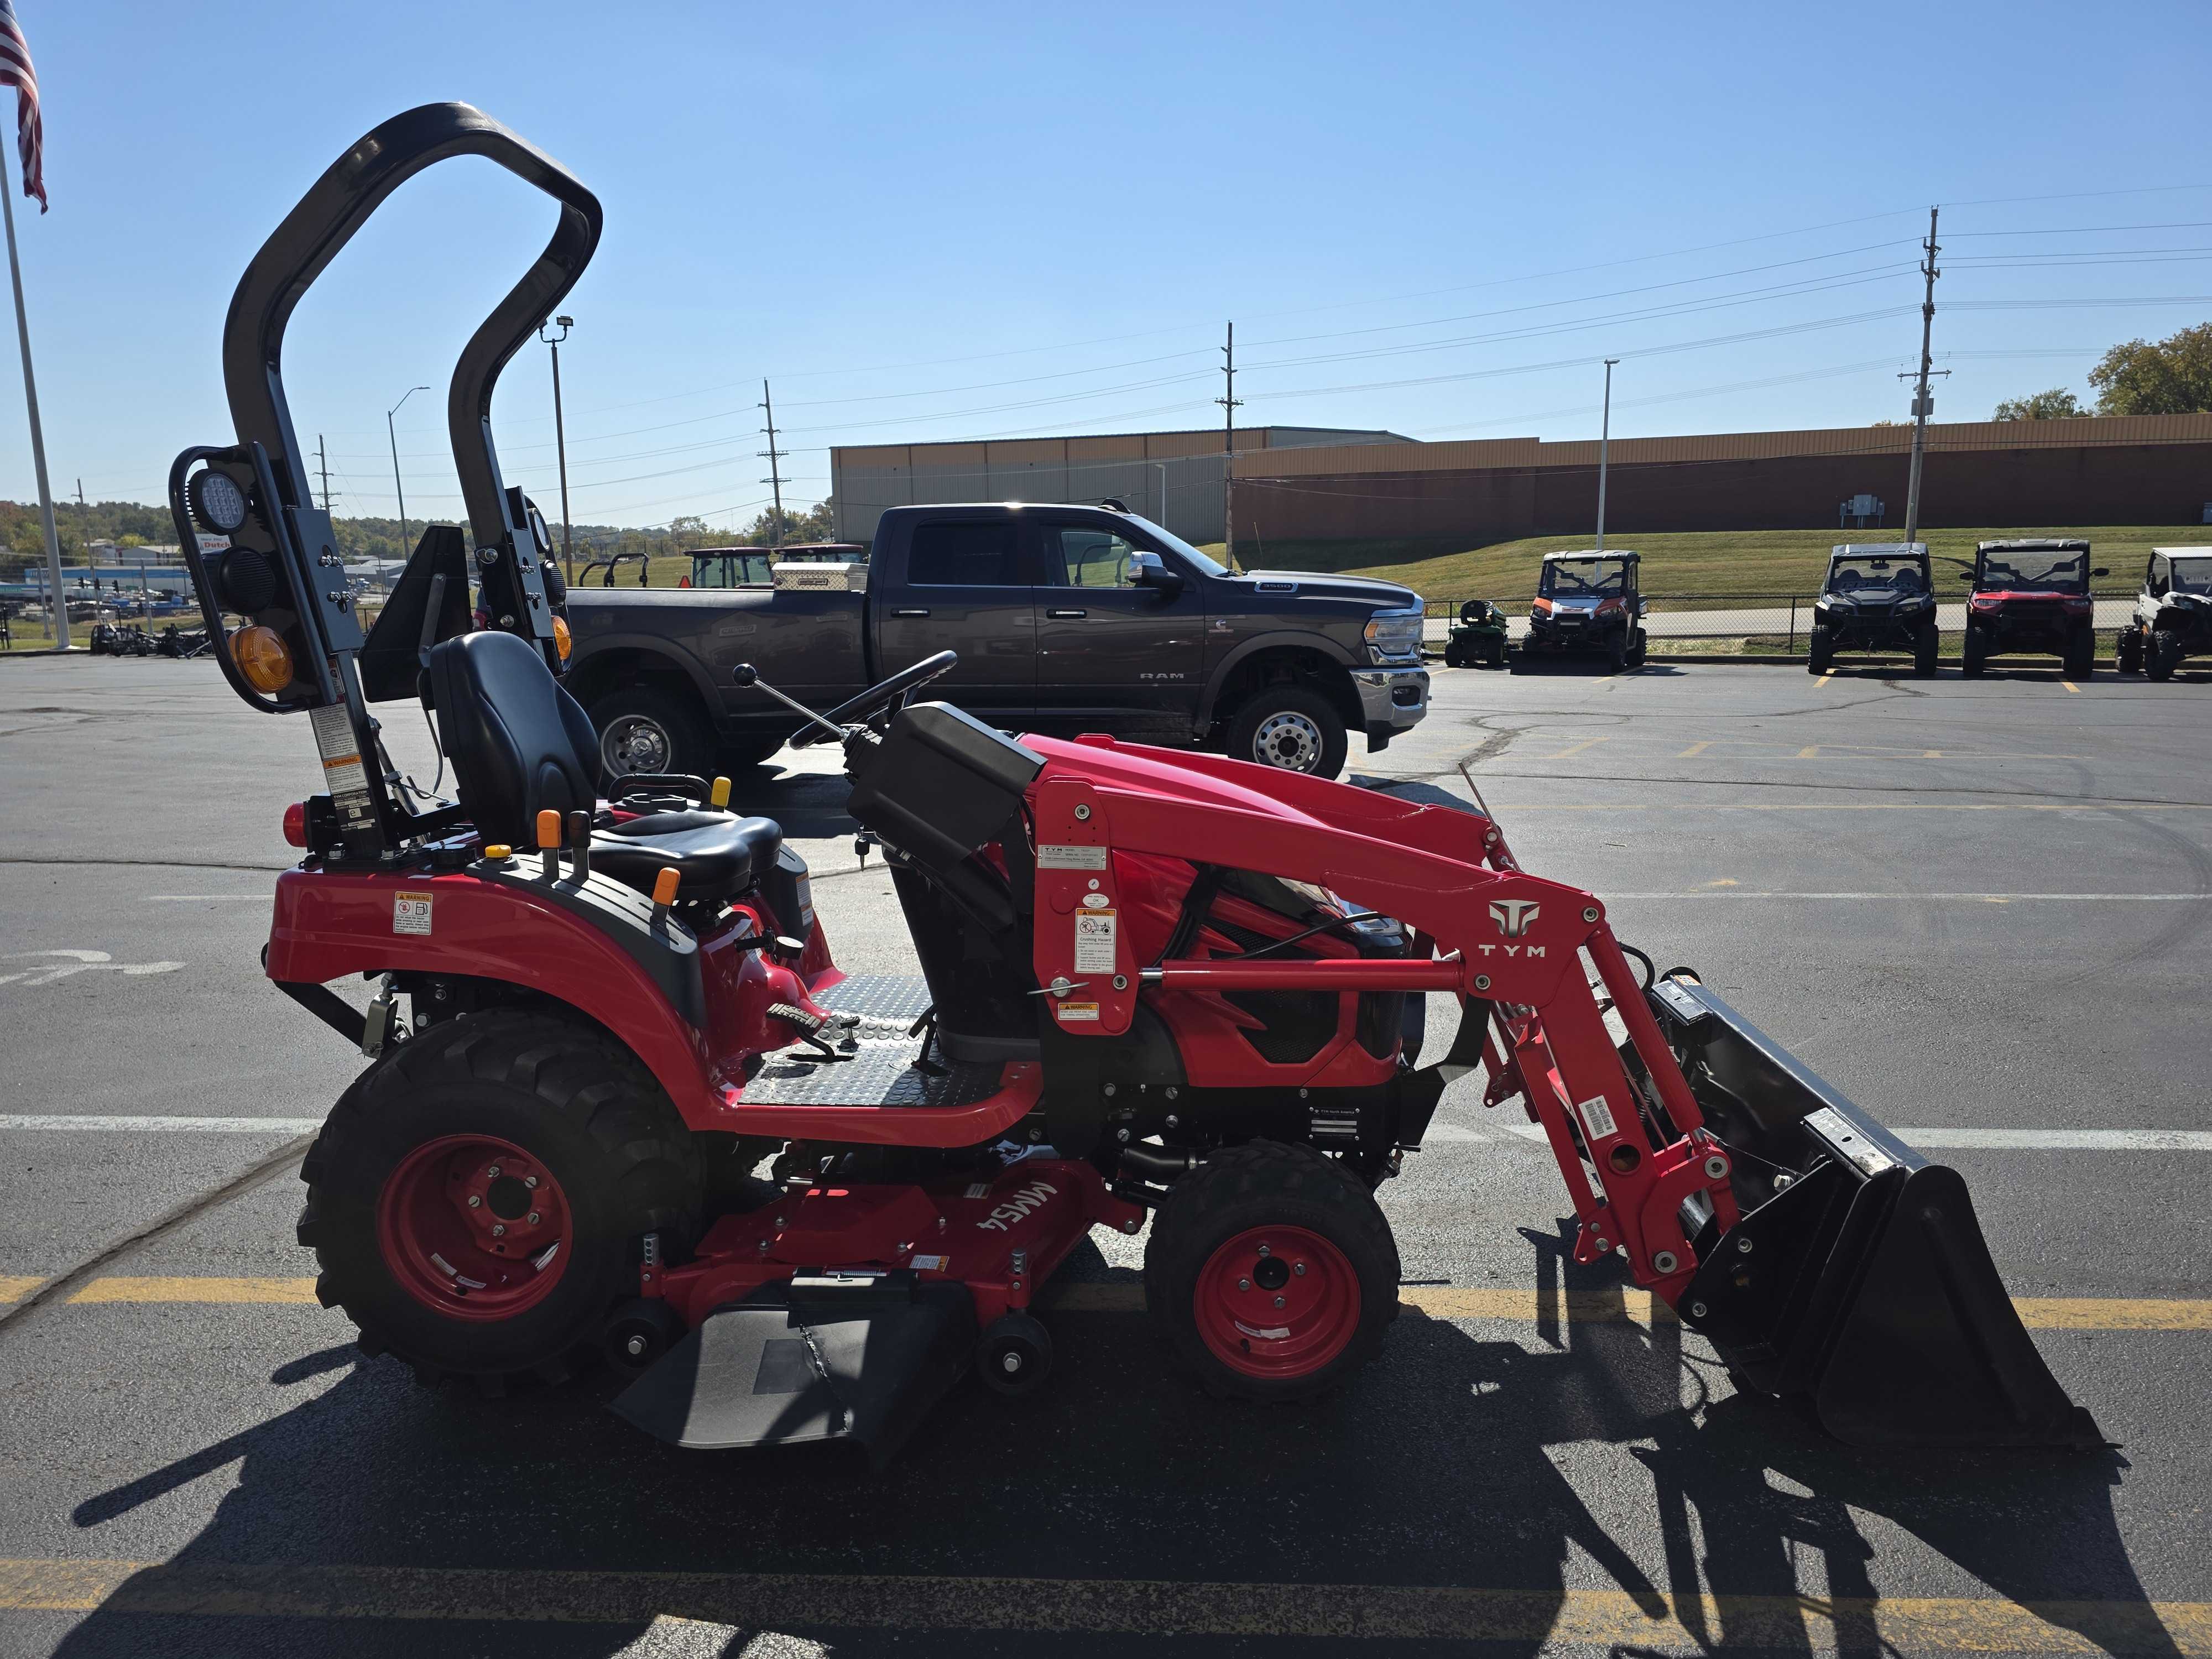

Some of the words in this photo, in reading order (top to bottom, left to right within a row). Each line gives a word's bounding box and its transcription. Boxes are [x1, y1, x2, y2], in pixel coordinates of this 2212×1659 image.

[333, 757, 358, 766] WARNING
[1478, 944, 1546, 958] TYM
[976, 1181, 1058, 1232] MM54
